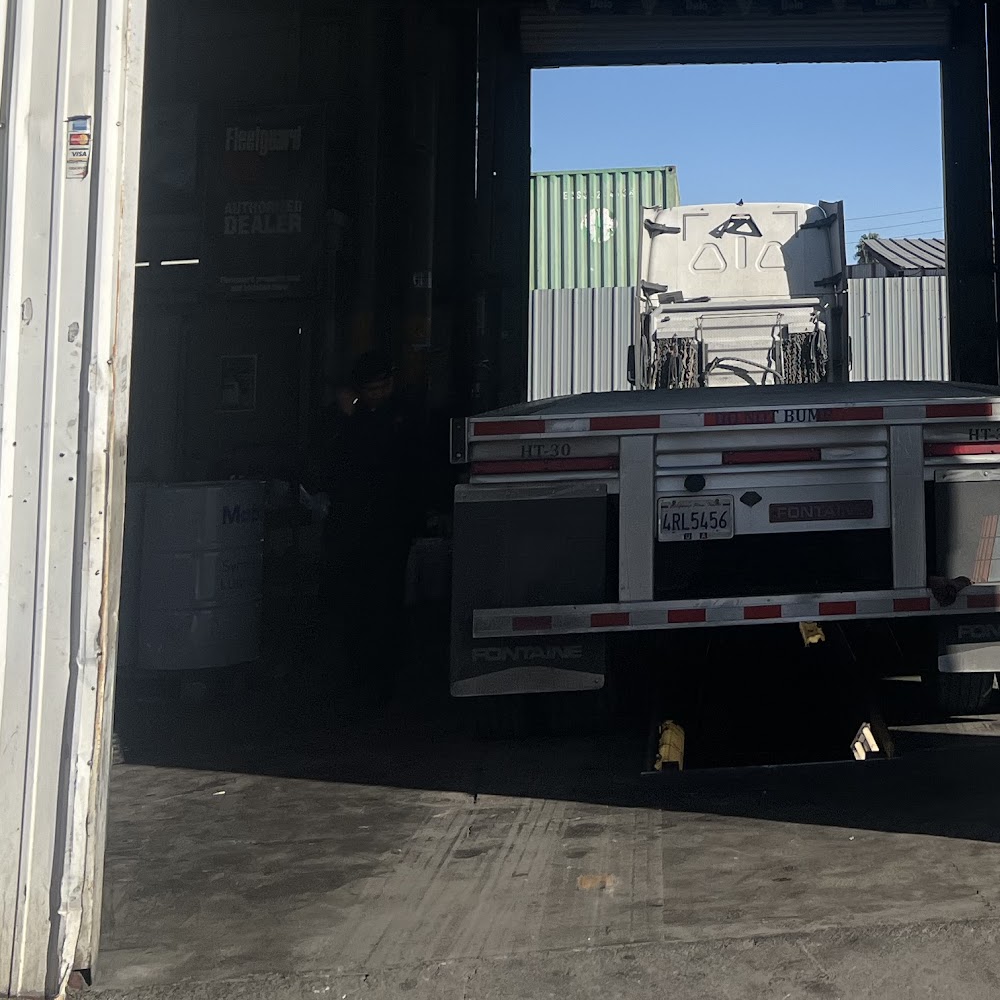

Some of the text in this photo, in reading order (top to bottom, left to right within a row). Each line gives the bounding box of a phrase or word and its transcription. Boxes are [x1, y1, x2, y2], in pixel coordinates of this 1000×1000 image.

[784, 408, 834, 423] BUM
[520, 443, 571, 459] HT-30
[662, 511, 728, 531] 4RL5456
[472, 643, 583, 662] FONTAINE
